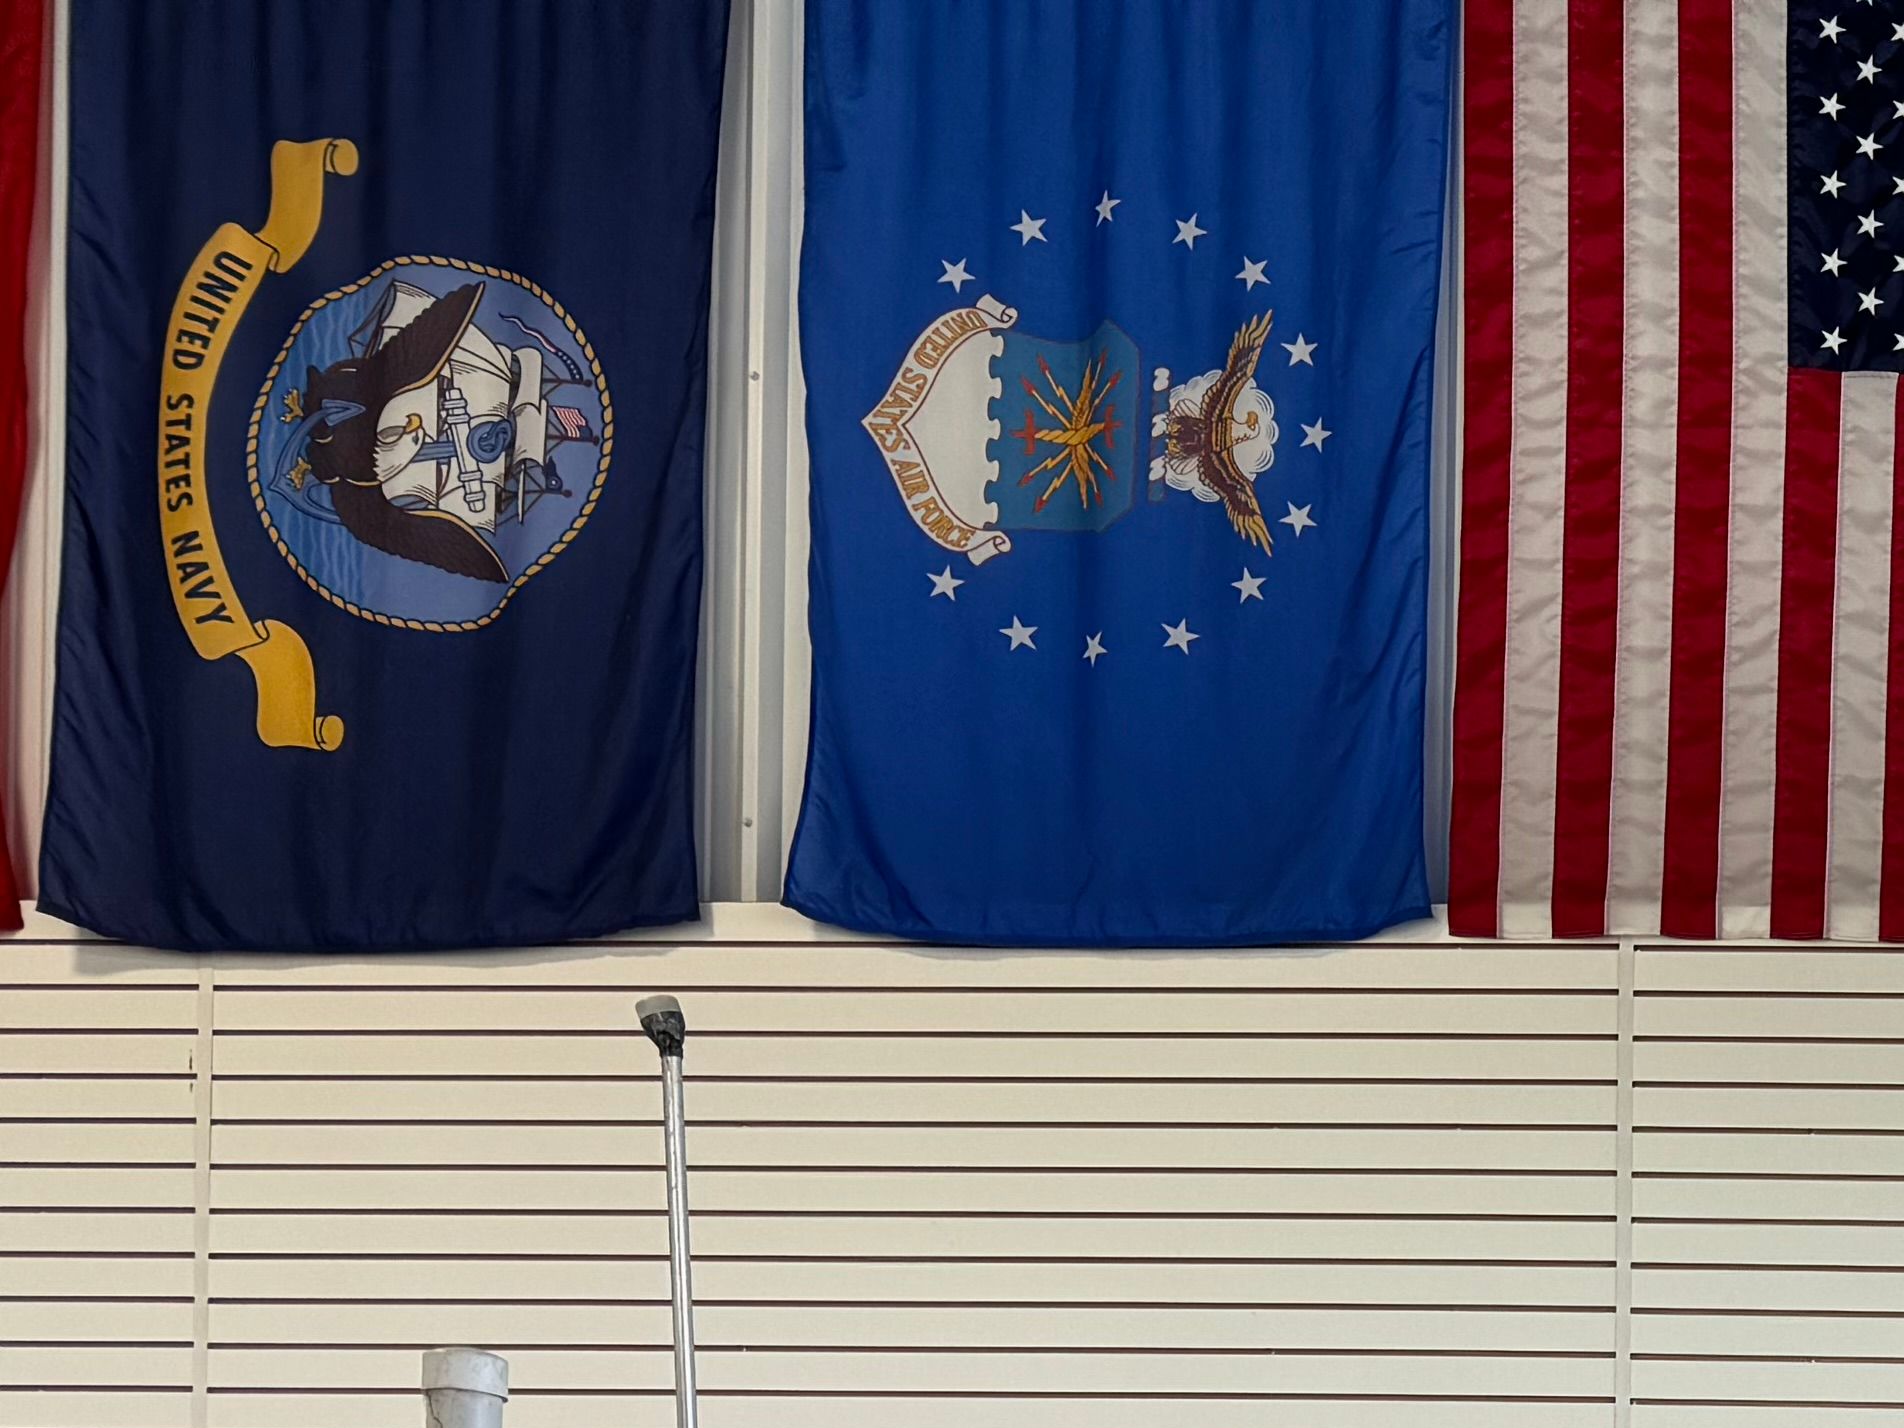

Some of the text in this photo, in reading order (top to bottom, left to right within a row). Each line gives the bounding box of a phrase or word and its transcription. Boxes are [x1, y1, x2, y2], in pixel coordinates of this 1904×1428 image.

[164, 250, 253, 626] UNITED STATES NAVY
[868, 309, 988, 549] UNITED STATES AIR FORCE
